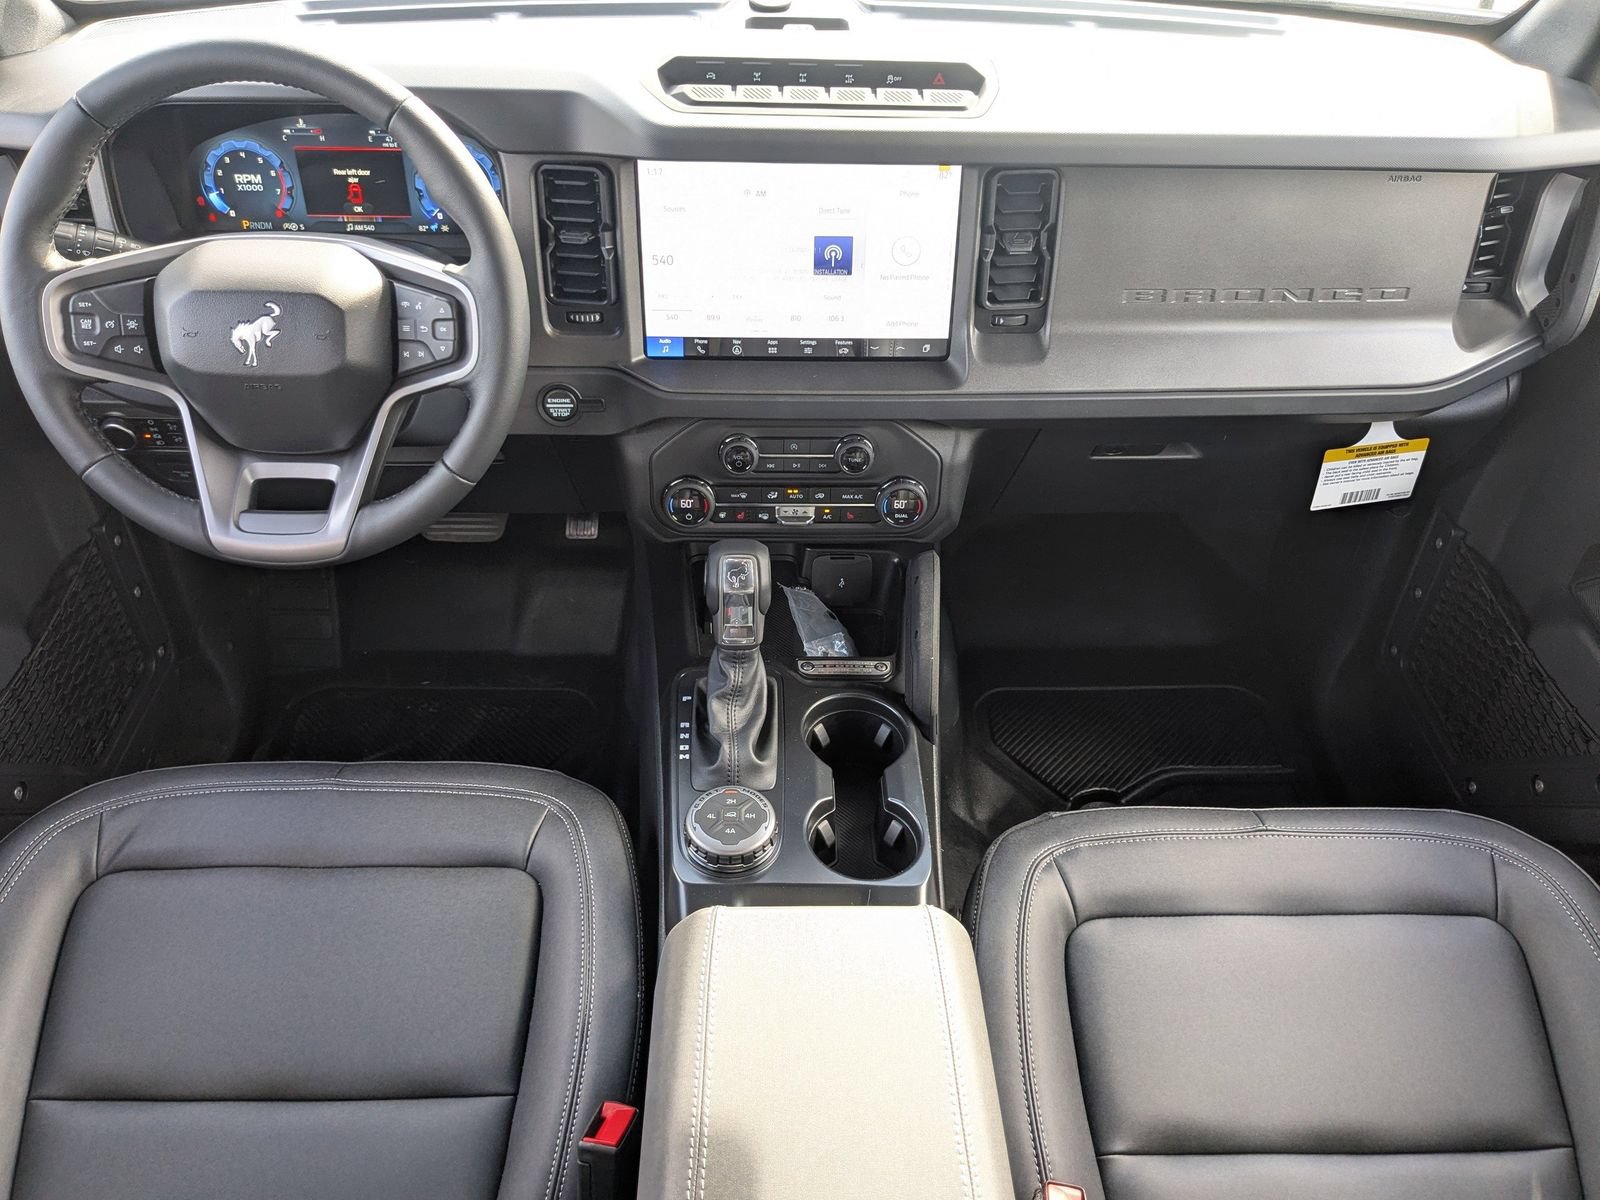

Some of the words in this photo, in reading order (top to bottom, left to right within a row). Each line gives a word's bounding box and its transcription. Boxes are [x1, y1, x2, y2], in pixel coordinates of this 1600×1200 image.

[234, 174, 262, 184] RPM
[1388, 174, 1422, 183] AIRBAG
[652, 254, 674, 266] 540
[1122, 287, 1410, 304] BRONCO
